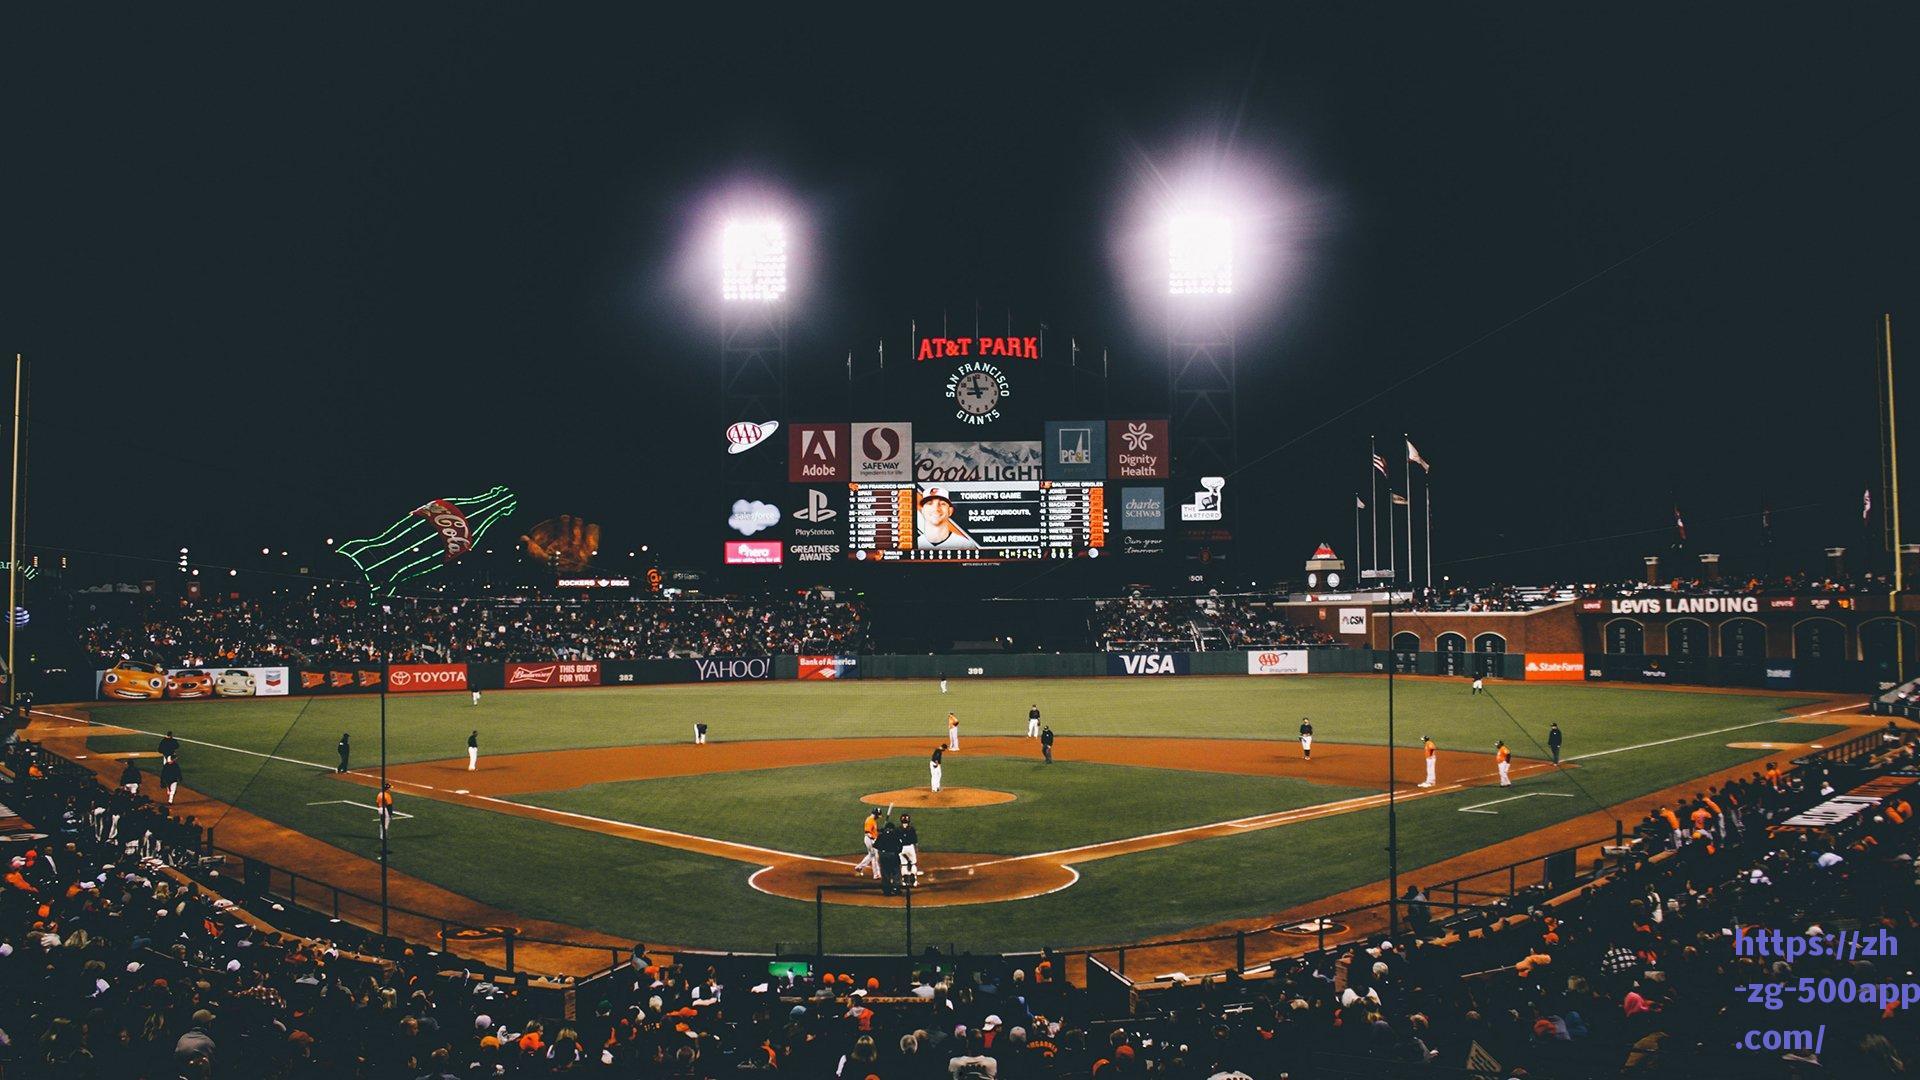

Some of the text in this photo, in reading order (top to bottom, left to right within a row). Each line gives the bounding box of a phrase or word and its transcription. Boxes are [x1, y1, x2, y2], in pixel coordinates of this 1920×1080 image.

[918, 336, 1039, 361] AT&T PARK
[945, 361, 1011, 398] SAN FRANCISCO
[956, 409, 1001, 426] GIANTS
[729, 423, 762, 444] AAA
[862, 462, 900, 470] SAFEWAY
[1119, 454, 1157, 467] Dignity
[802, 464, 836, 476] Adobe
[914, 458, 1042, 482] Coors LIGHT
[1121, 466, 1156, 477] Health
[960, 492, 1022, 500] TONIGHT'S GAME
[1126, 499, 1160, 510] charles
[985, 509, 1031, 517] GROUNDOUTS,
[1126, 510, 1161, 518] SCHWAB
[795, 528, 835, 537] PlayStation
[790, 545, 840, 554] GREATNESS
[798, 553, 832, 562] AWAITS
[558, 579, 630, 587] DOCKERS DECK
[1665, 597, 1759, 613] LANDING
[1349, 616, 1365, 625] CSN
[800, 658, 857, 666] Bank of America
[1119, 654, 1176, 675] VISA
[1258, 653, 1280, 666] AAA
[514, 669, 552, 679] Budweiser
[559, 663, 598, 674] THIS BUD'S
[695, 658, 771, 681] YAHOO!
[413, 671, 467, 683] TOYOTA
[559, 673, 590, 683] FOR YOU.
[618, 674, 634, 682] 382
